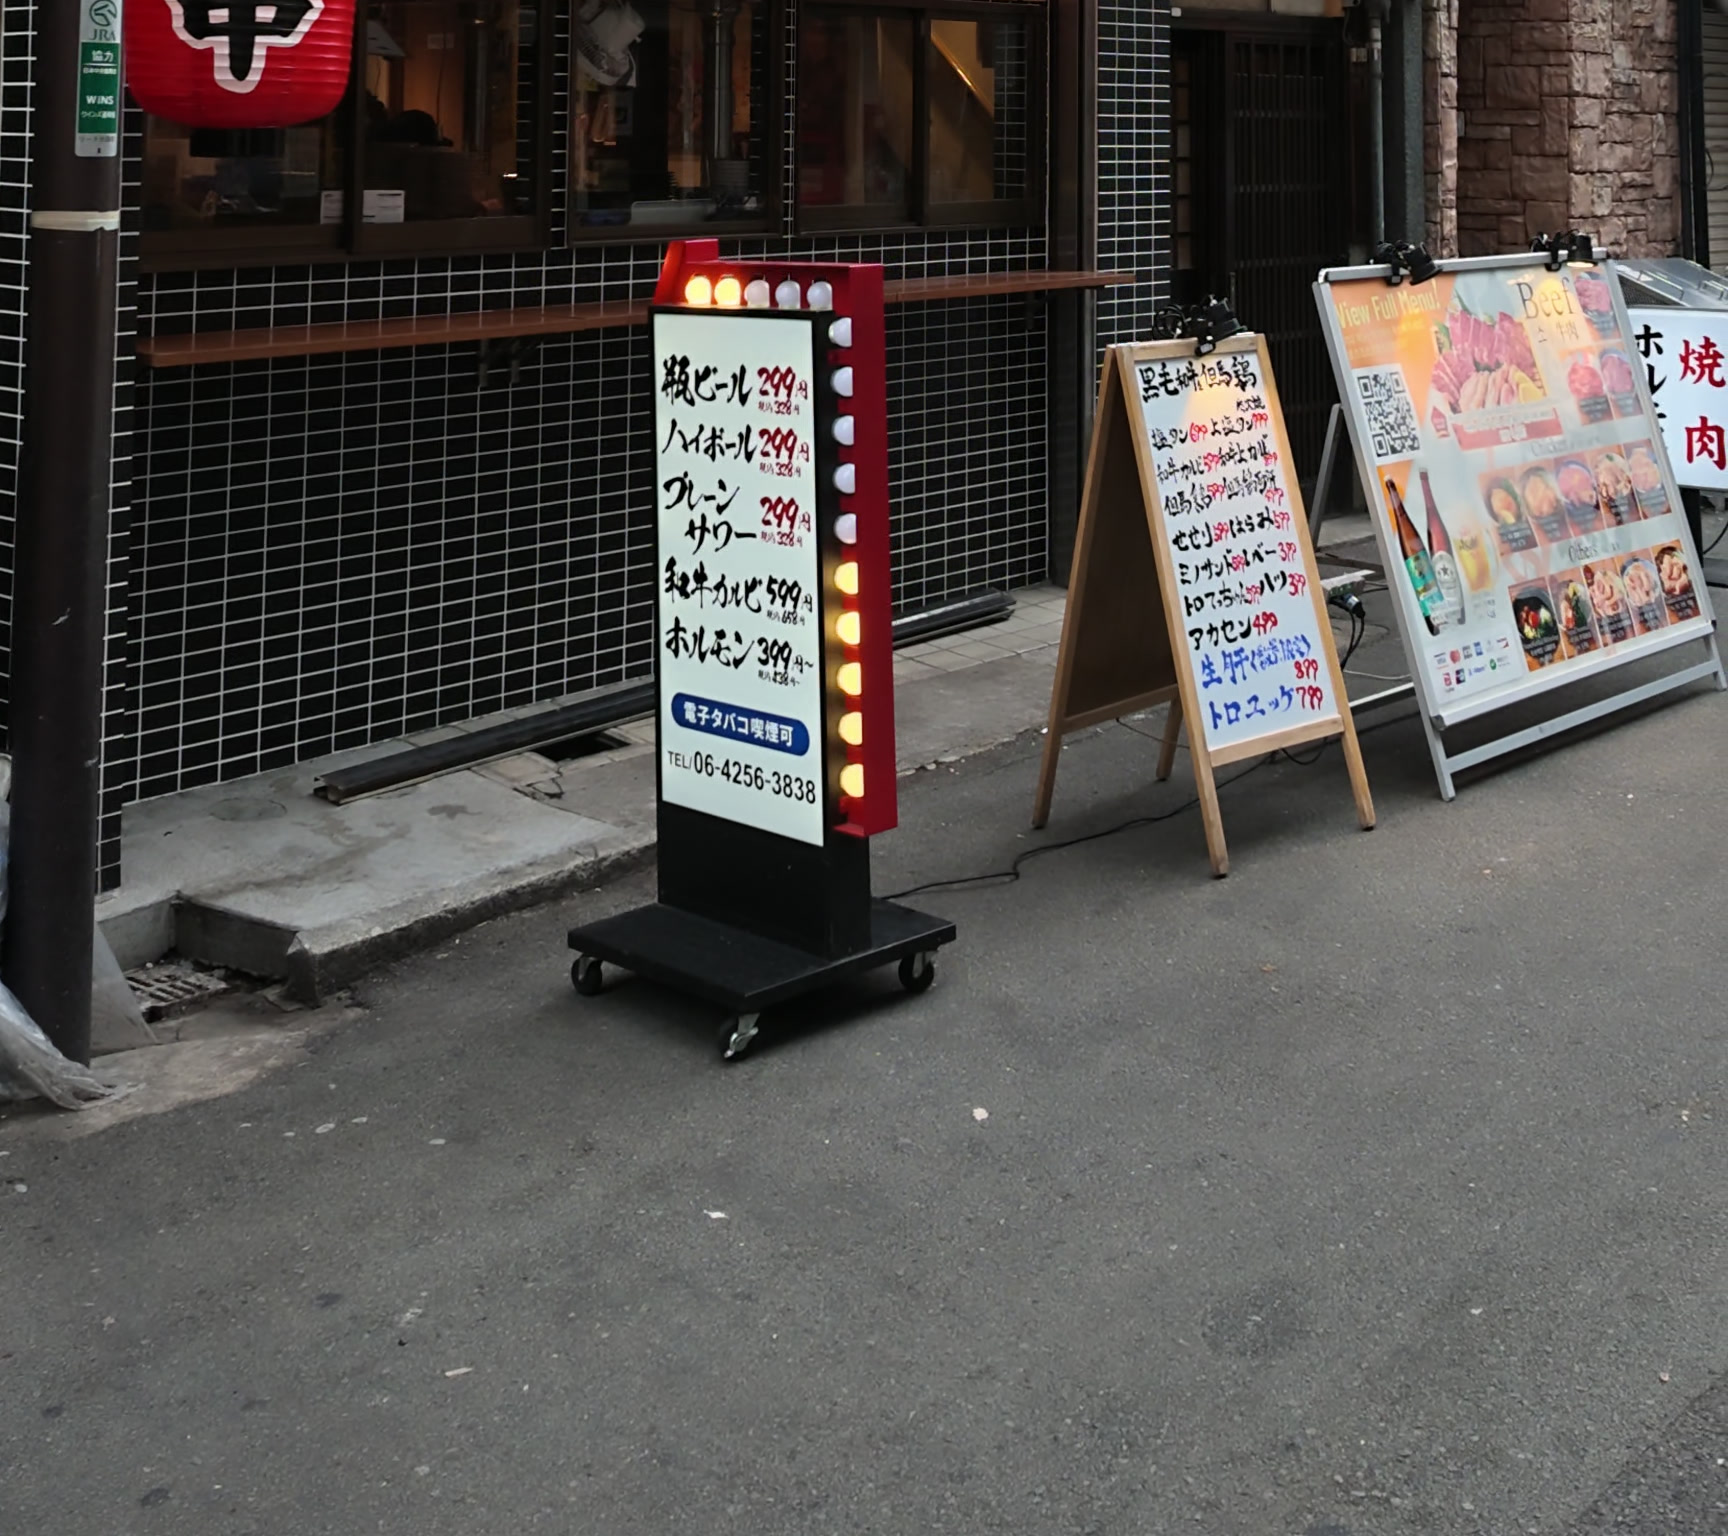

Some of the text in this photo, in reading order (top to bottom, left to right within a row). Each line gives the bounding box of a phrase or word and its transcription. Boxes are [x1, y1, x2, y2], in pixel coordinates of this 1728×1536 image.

[89, 29, 116, 41] JRA
[91, 50, 114, 63] 協力
[86, 95, 114, 105] WINS
[1335, 302, 1369, 329] View
[1371, 293, 1397, 319] Full
[1399, 279, 1441, 314] Menu!
[1516, 276, 1577, 320] Beef
[661, 354, 808, 407] 瓶ビール 299円
[1679, 335, 1727, 470] 焼肉
[662, 418, 810, 464] ハイボール 299円
[1151, 427, 1188, 451] 塩タン
[662, 471, 740, 515] プレーン
[684, 496, 811, 555] サワー 299円
[1172, 521, 1213, 552] せせり
[1229, 506, 1274, 539] はらみ
[664, 555, 814, 614] 和牛カルビ 599円
[1178, 549, 1234, 585] ミノサンド
[1260, 570, 1287, 596] ハツ
[1287, 573, 1306, 597] 399
[665, 616, 755, 670] ホルモン
[1188, 611, 1278, 651] アカセン 499
[1294, 658, 1319, 682] 899
[683, 701, 794, 748] 電子タバコ喫煙可
[1208, 684, 1323, 730] トロユッケ 799
